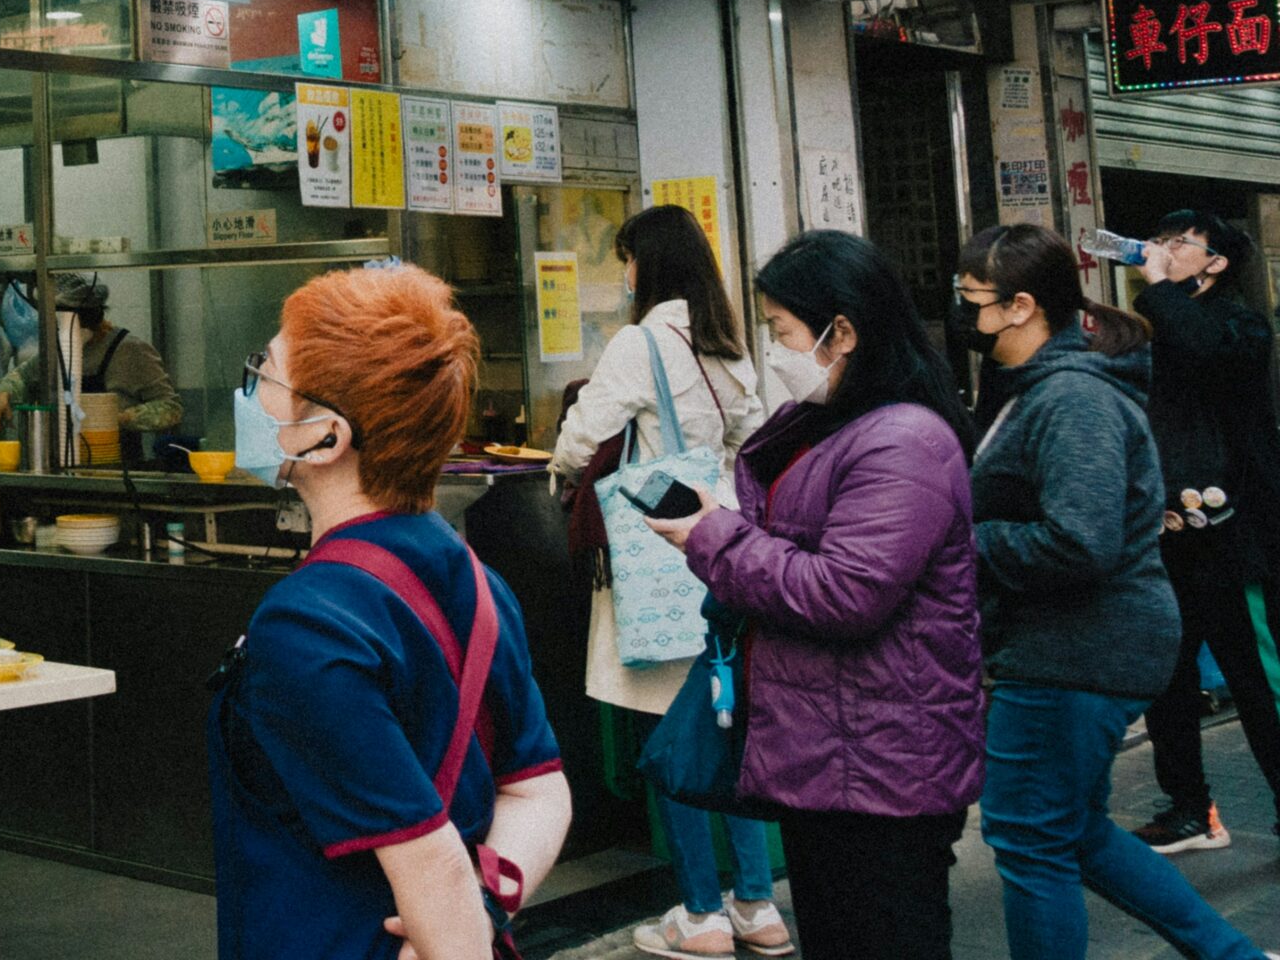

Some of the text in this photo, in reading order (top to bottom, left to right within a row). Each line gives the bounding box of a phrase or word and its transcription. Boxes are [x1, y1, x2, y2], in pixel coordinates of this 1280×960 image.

[150, 21, 202, 35] NO SMOKING
[213, 216, 255, 231] 小心地滑
